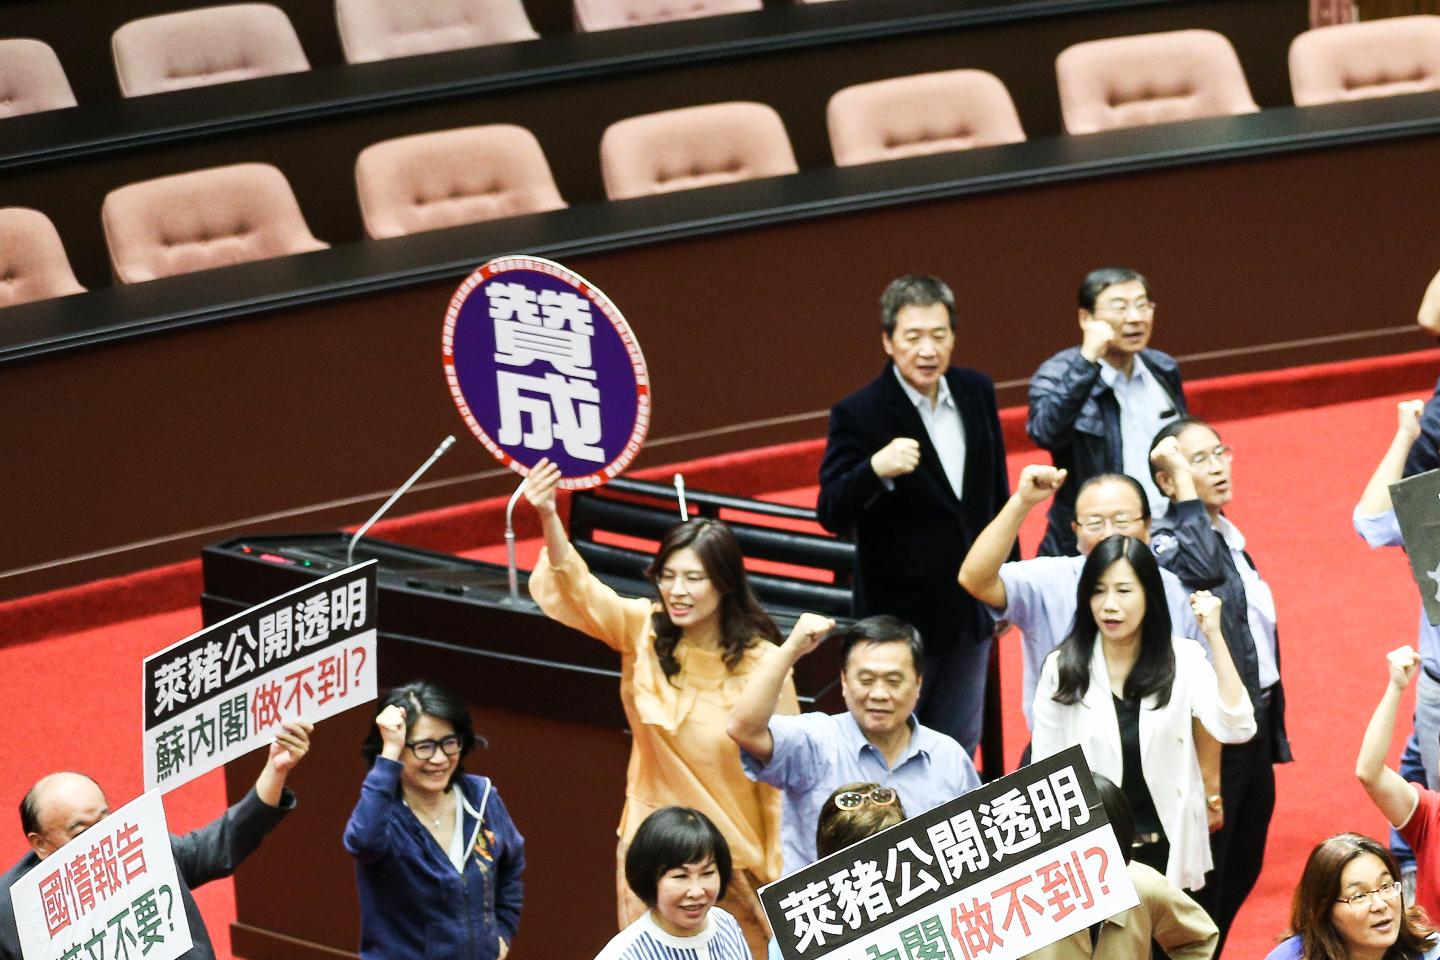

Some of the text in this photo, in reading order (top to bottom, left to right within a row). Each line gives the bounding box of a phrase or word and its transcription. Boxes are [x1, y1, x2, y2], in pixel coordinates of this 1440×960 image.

[485, 281, 606, 463] 贊成
[153, 577, 367, 717] 萊豬公開透明
[155, 646, 367, 784] 蘇內閣做不到?
[38, 822, 147, 940] 國情報告
[779, 765, 1091, 954] 萊豬公開透明
